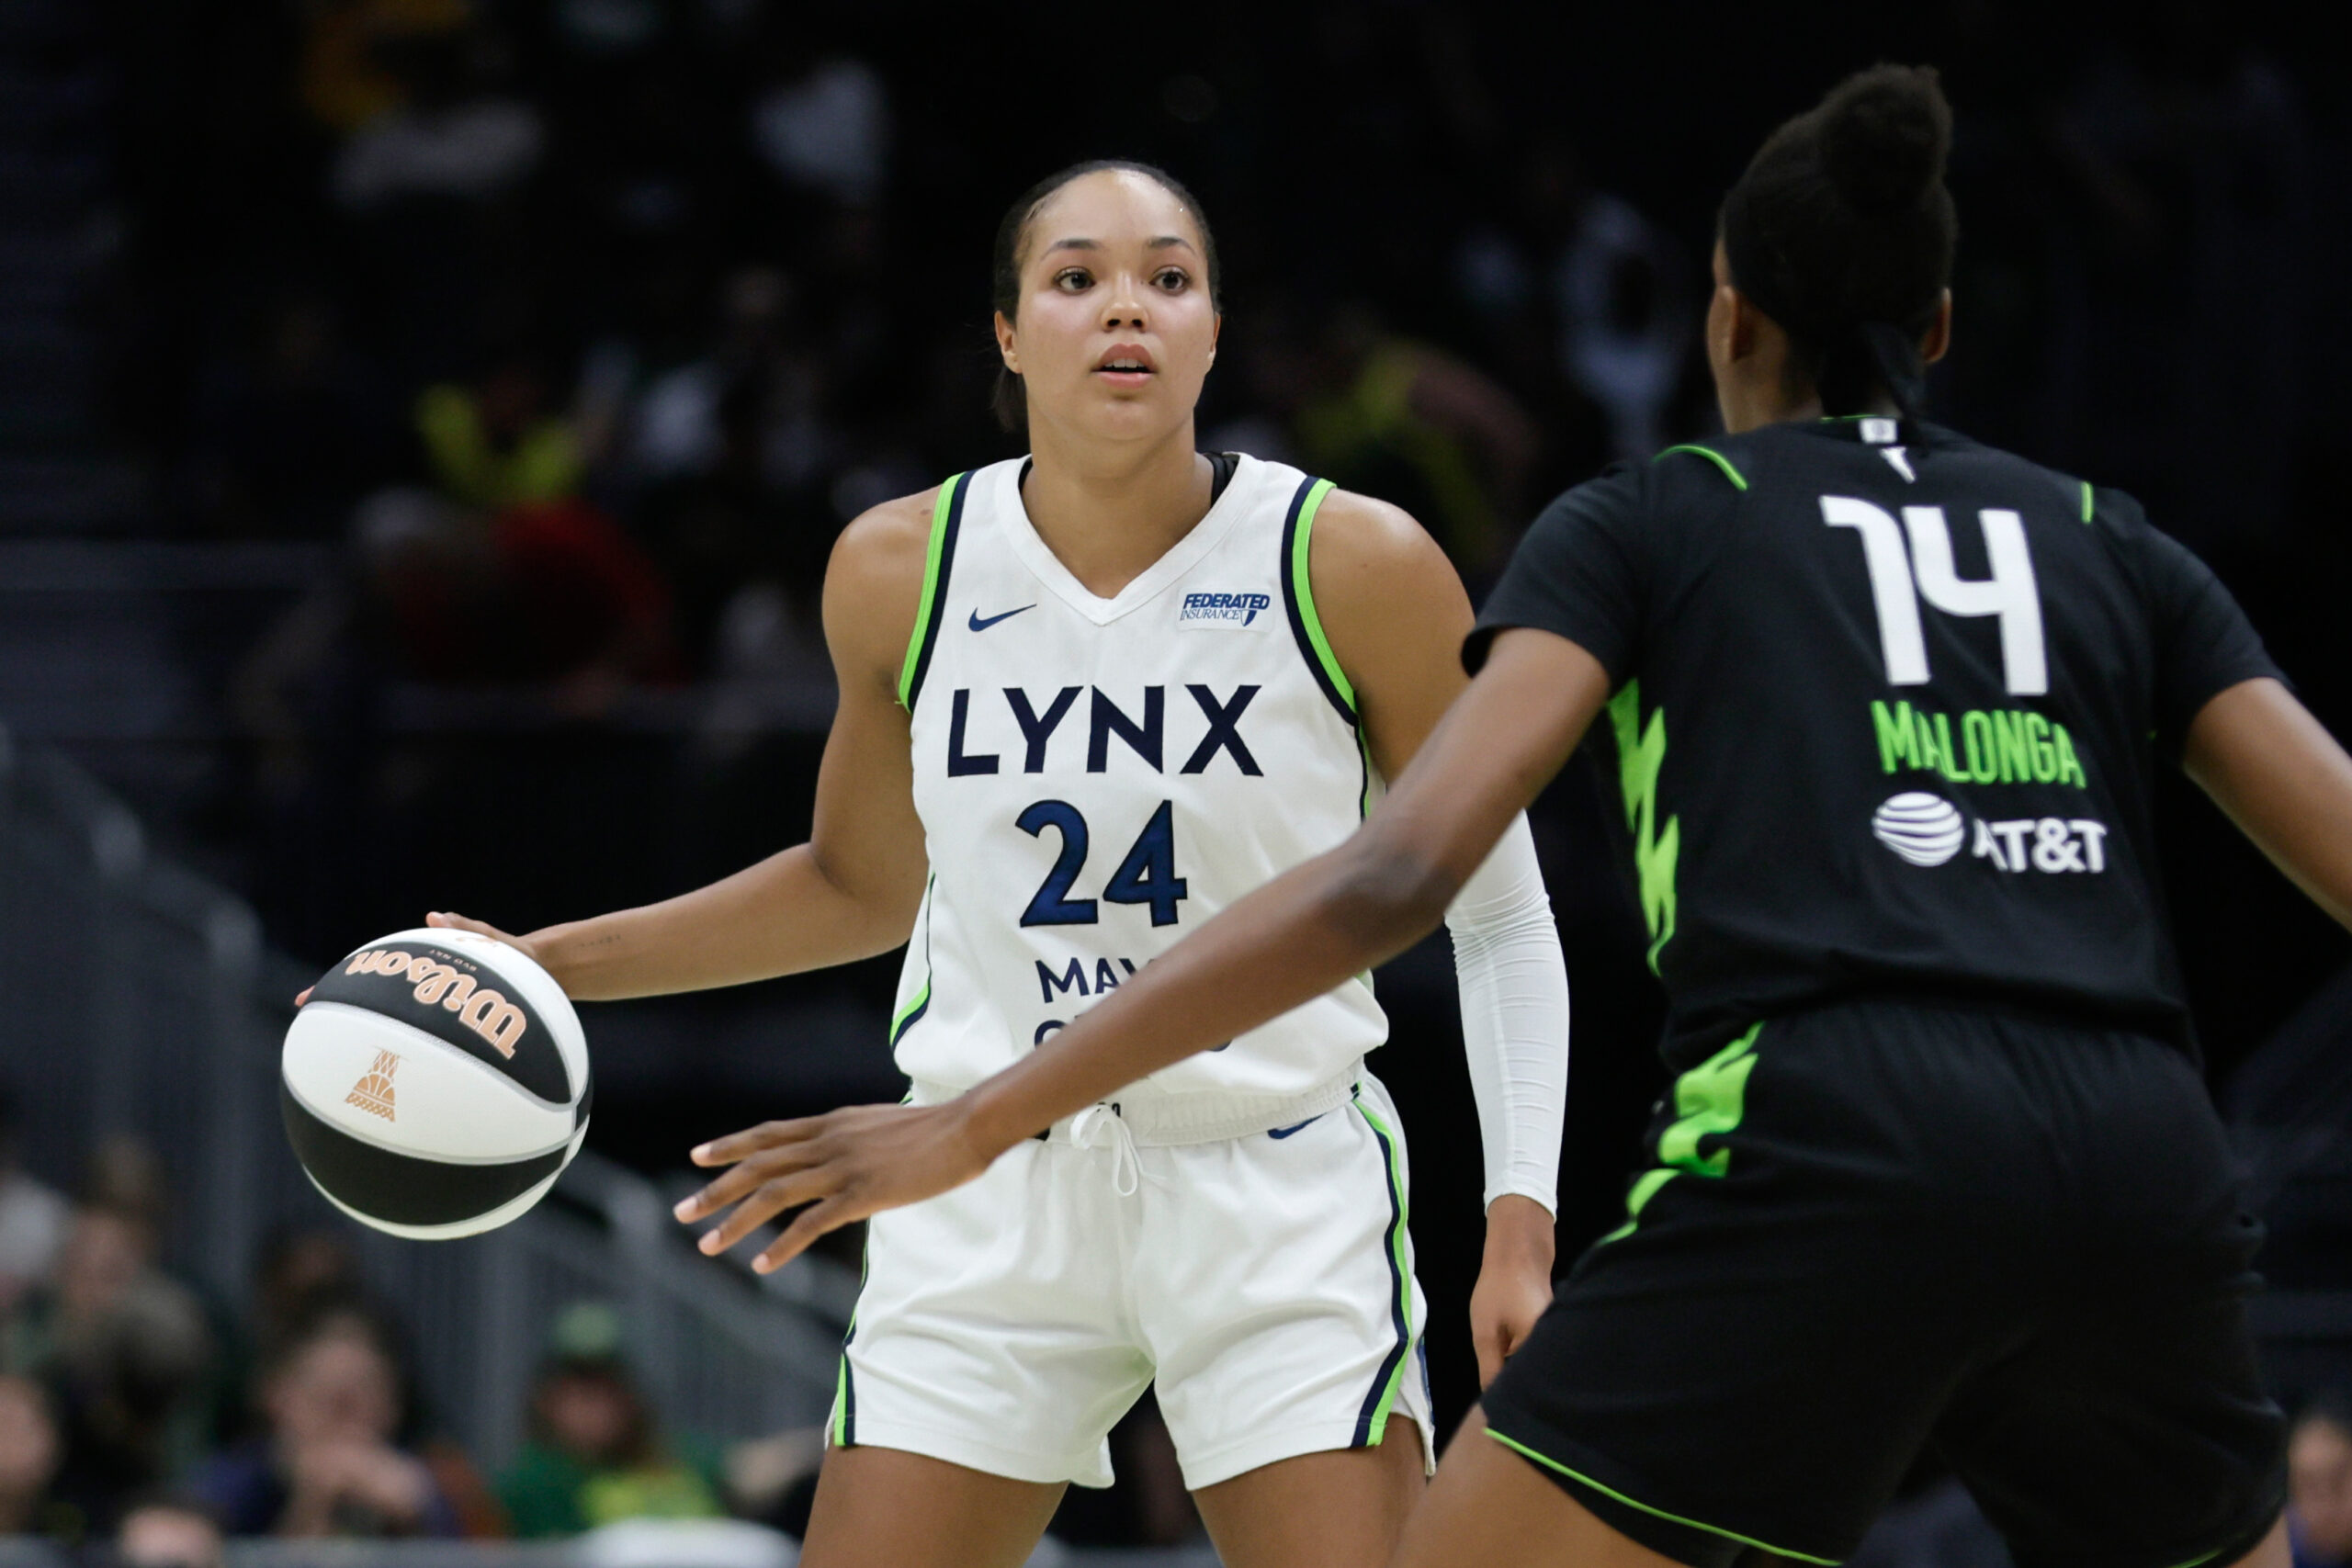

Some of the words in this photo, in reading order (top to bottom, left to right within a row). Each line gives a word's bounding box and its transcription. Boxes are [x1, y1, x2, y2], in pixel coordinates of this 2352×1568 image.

[1180, 609, 1241, 621] INSURANCE
[1182, 592, 1271, 610] FEDERATED
[1819, 494, 2049, 696] 14
[947, 684, 1264, 778] LYNX
[1871, 700, 2086, 789] MALONGA
[1014, 798, 1188, 929] 24
[1972, 817, 2109, 873] AT&T
[345, 949, 526, 1060] Wilson
